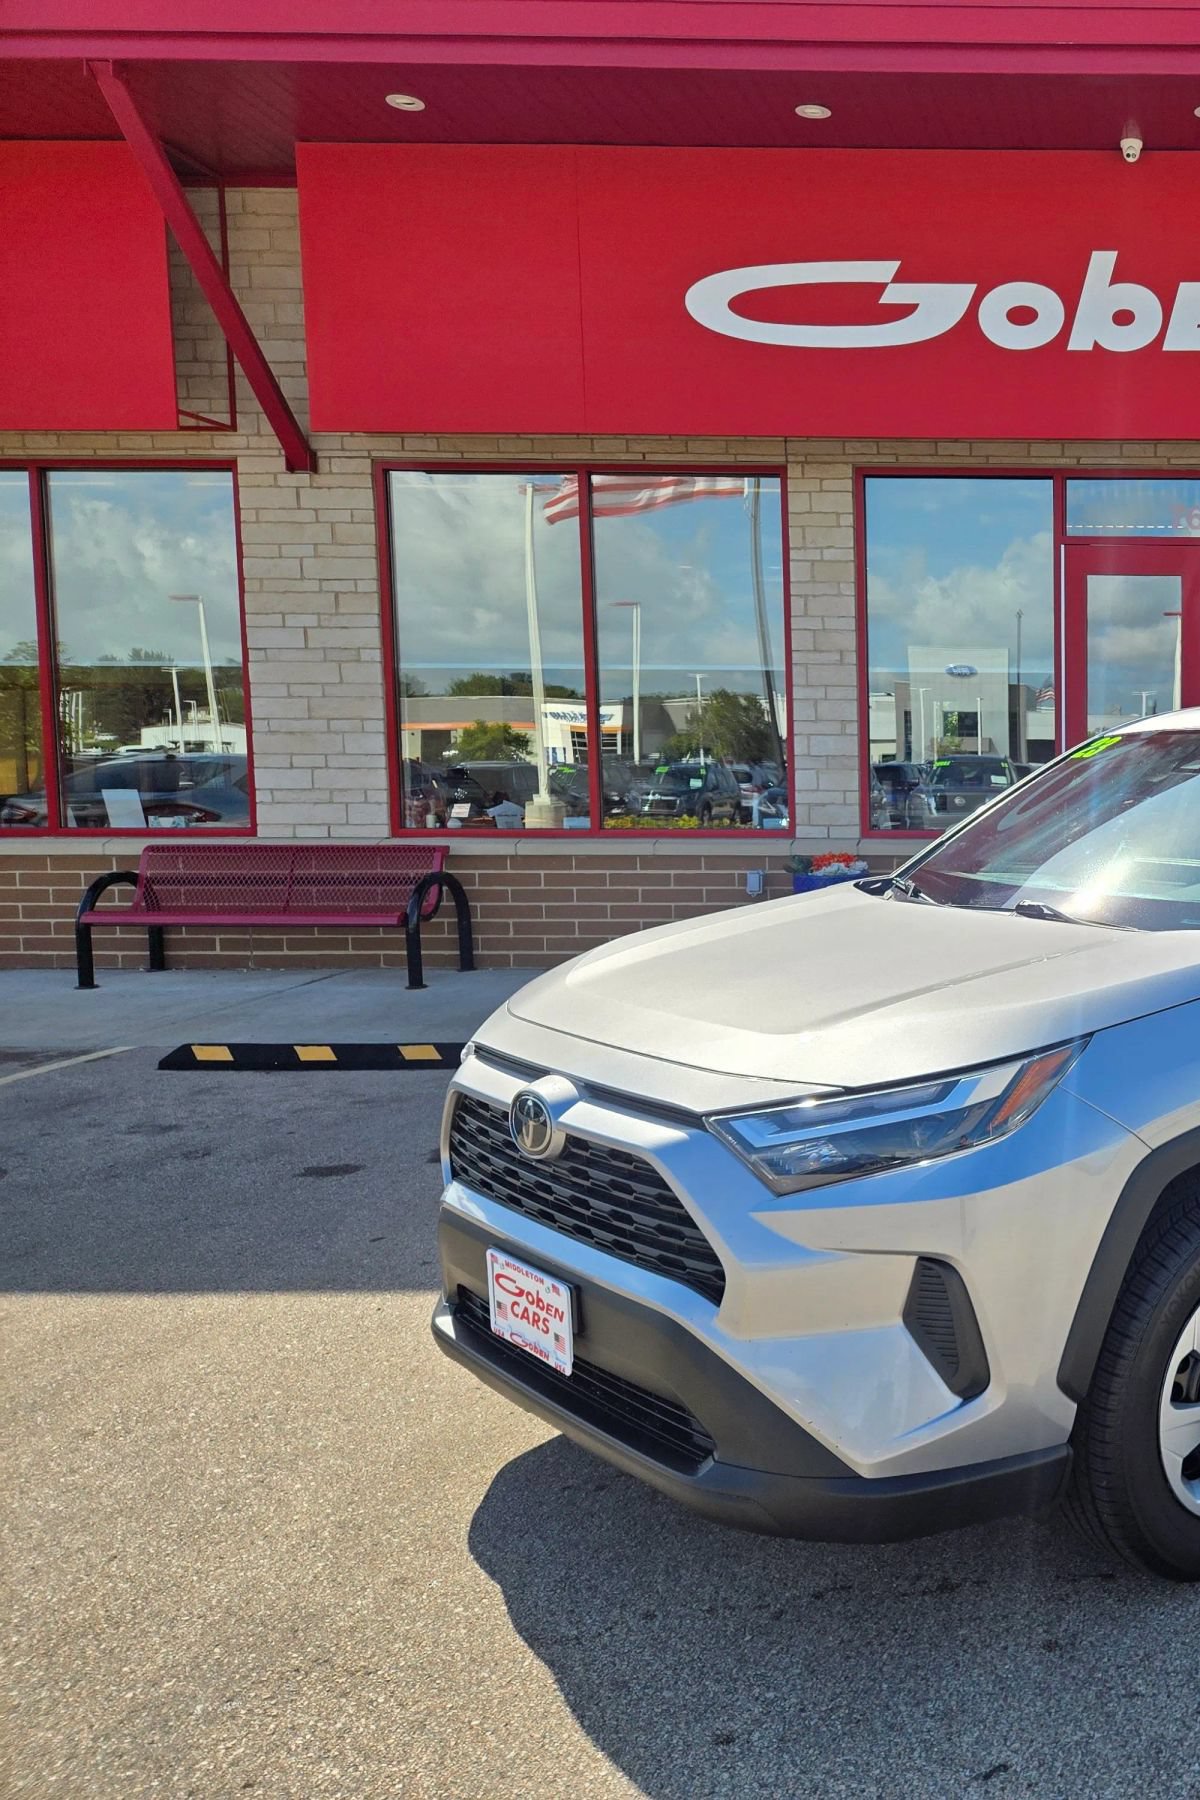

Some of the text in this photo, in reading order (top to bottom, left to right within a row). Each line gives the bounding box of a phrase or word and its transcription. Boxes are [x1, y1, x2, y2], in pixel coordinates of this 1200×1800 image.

[504, 1259, 545, 1286] MIDDLETON
[510, 1301, 550, 1335] CARS
[493, 1327, 505, 1338] USA
[554, 1361, 566, 1374] USA
